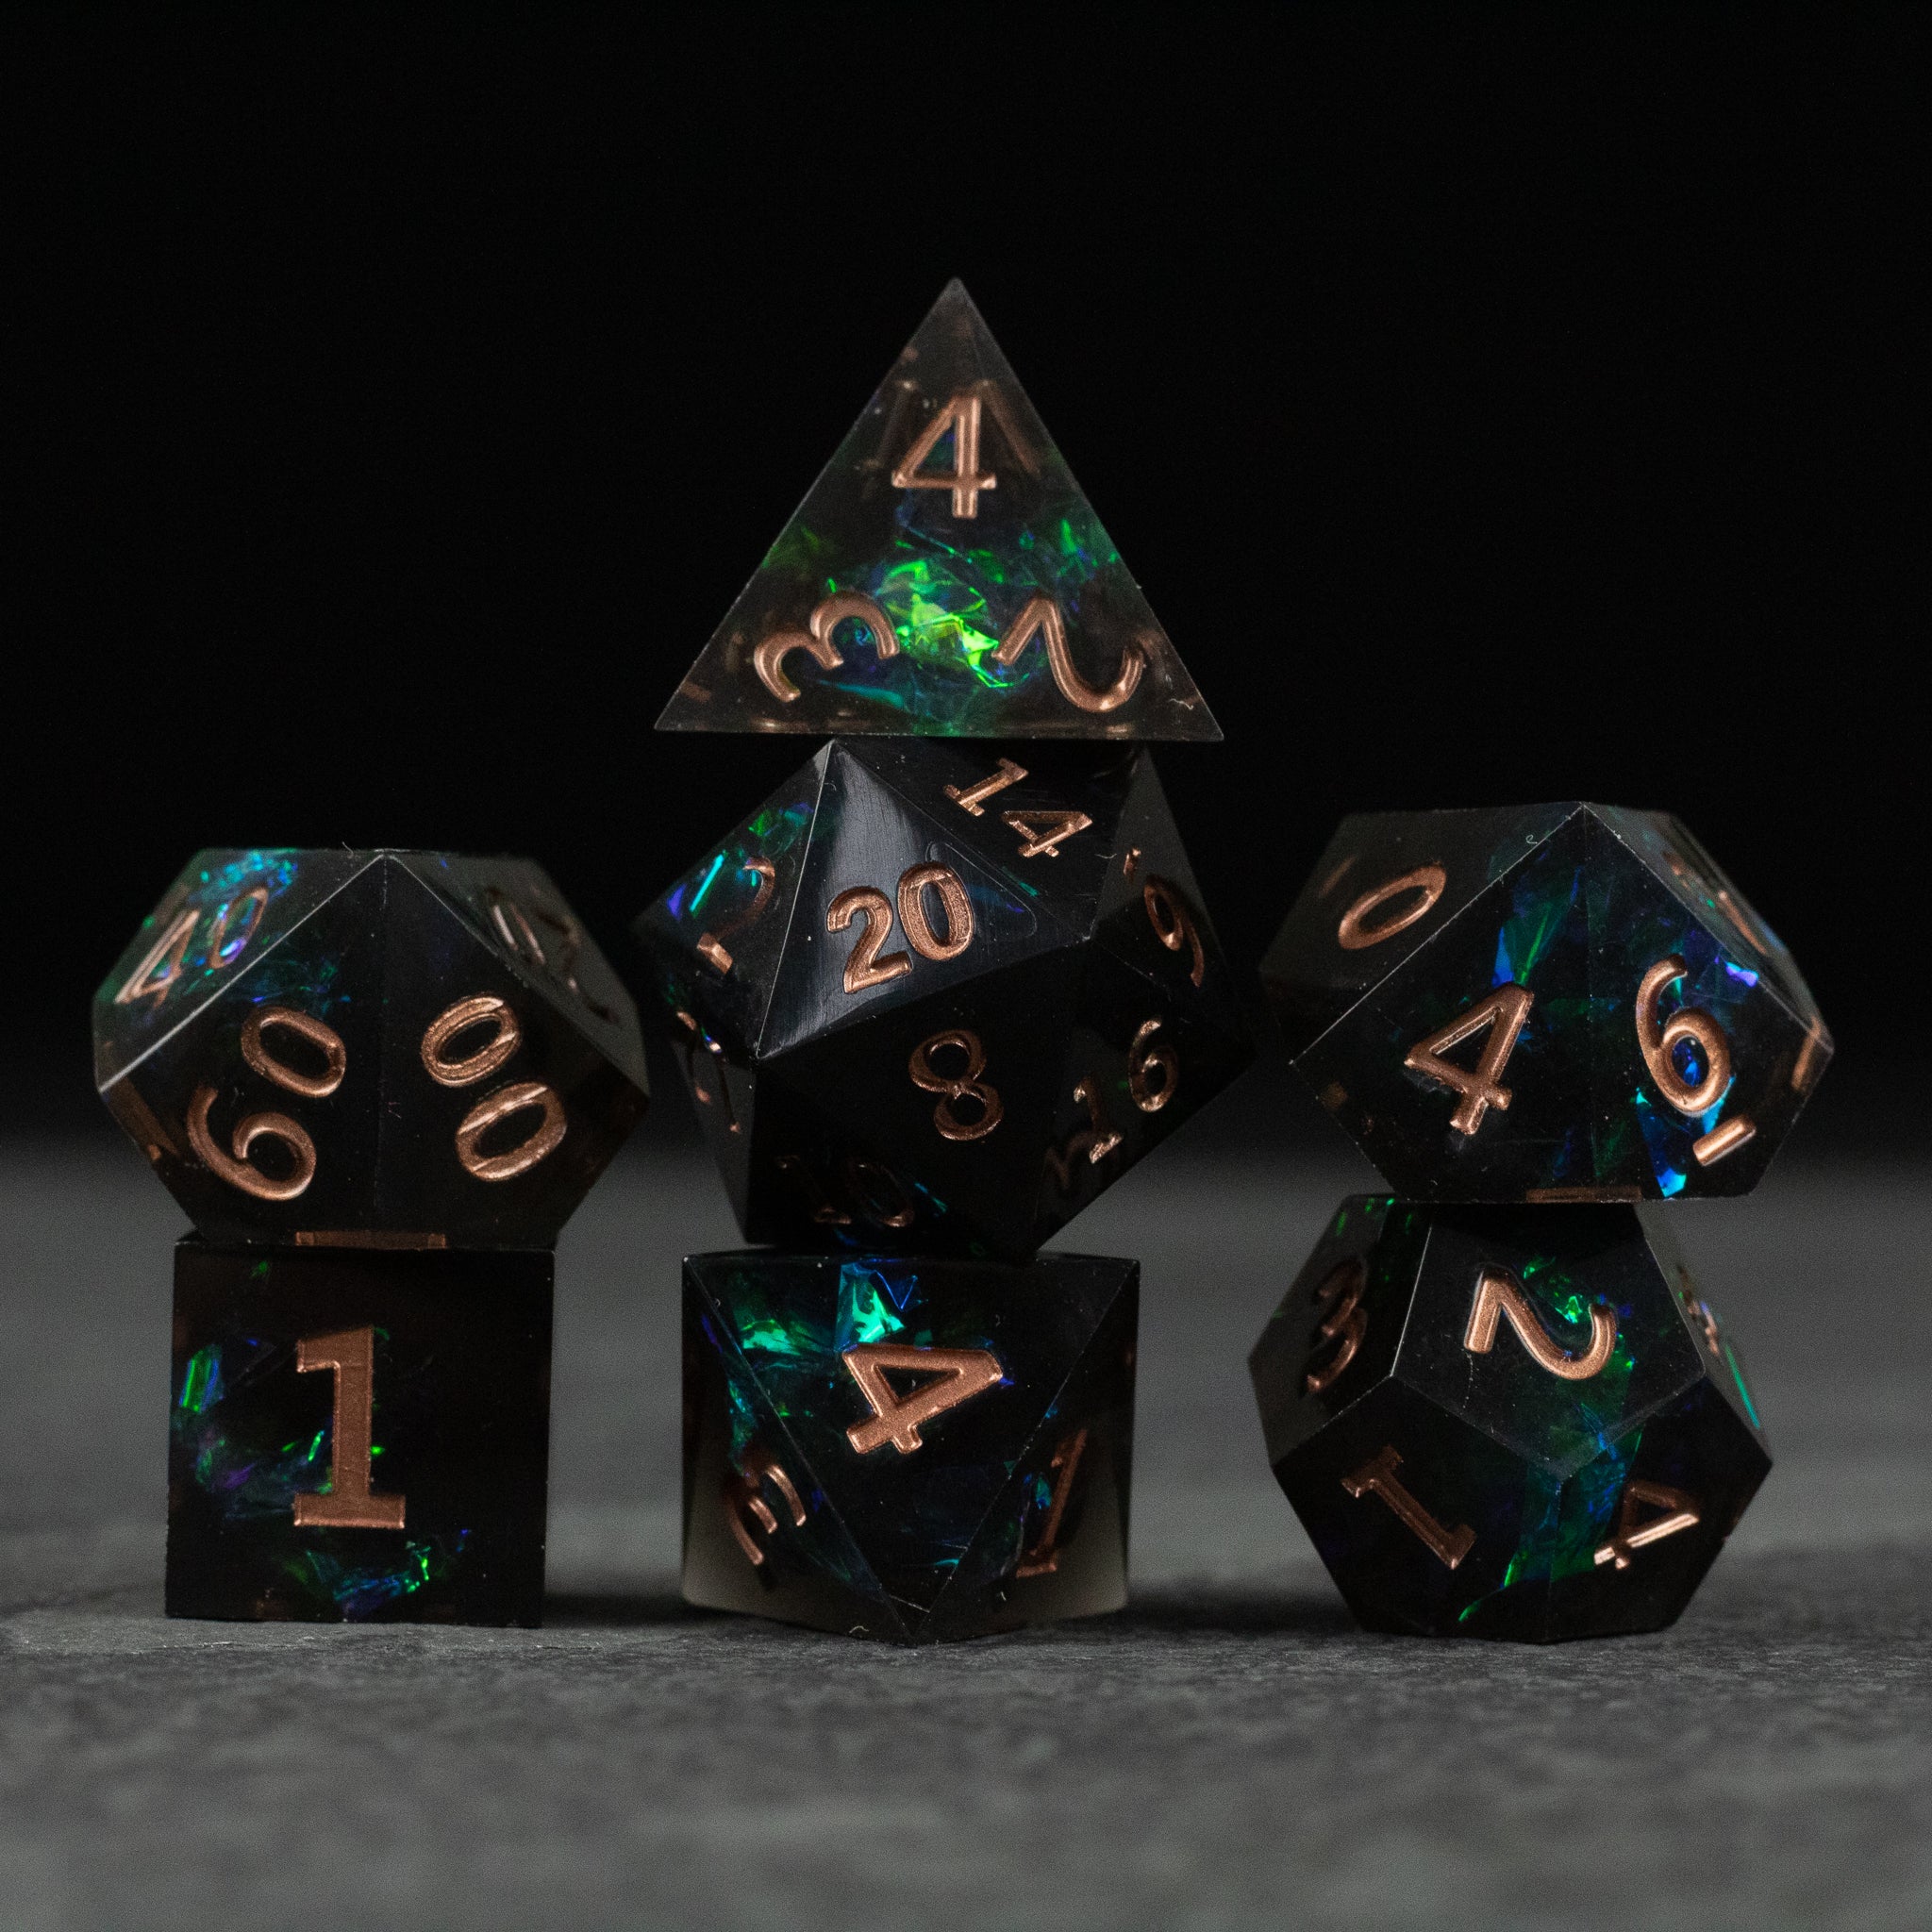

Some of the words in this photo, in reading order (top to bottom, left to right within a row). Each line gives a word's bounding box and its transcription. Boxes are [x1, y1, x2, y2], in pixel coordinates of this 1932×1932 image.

[891, 392, 997, 520] 4
[754, 592, 901, 703] 3
[991, 593, 1145, 713] 2
[943, 757, 1094, 859] 14
[826, 860, 976, 994] 20
[1339, 861, 1447, 951] 0
[420, 991, 568, 1182] 00
[908, 1028, 1006, 1141] 8
[1404, 982, 1535, 1136] 4
[1463, 1265, 1618, 1381] 2
[293, 1324, 407, 1530] 1
[841, 1343, 1004, 1455] 4
[1015, 1428, 1088, 1580] 1
[1340, 1443, 1477, 1571] 1
[1592, 1480, 1699, 1571] 4
